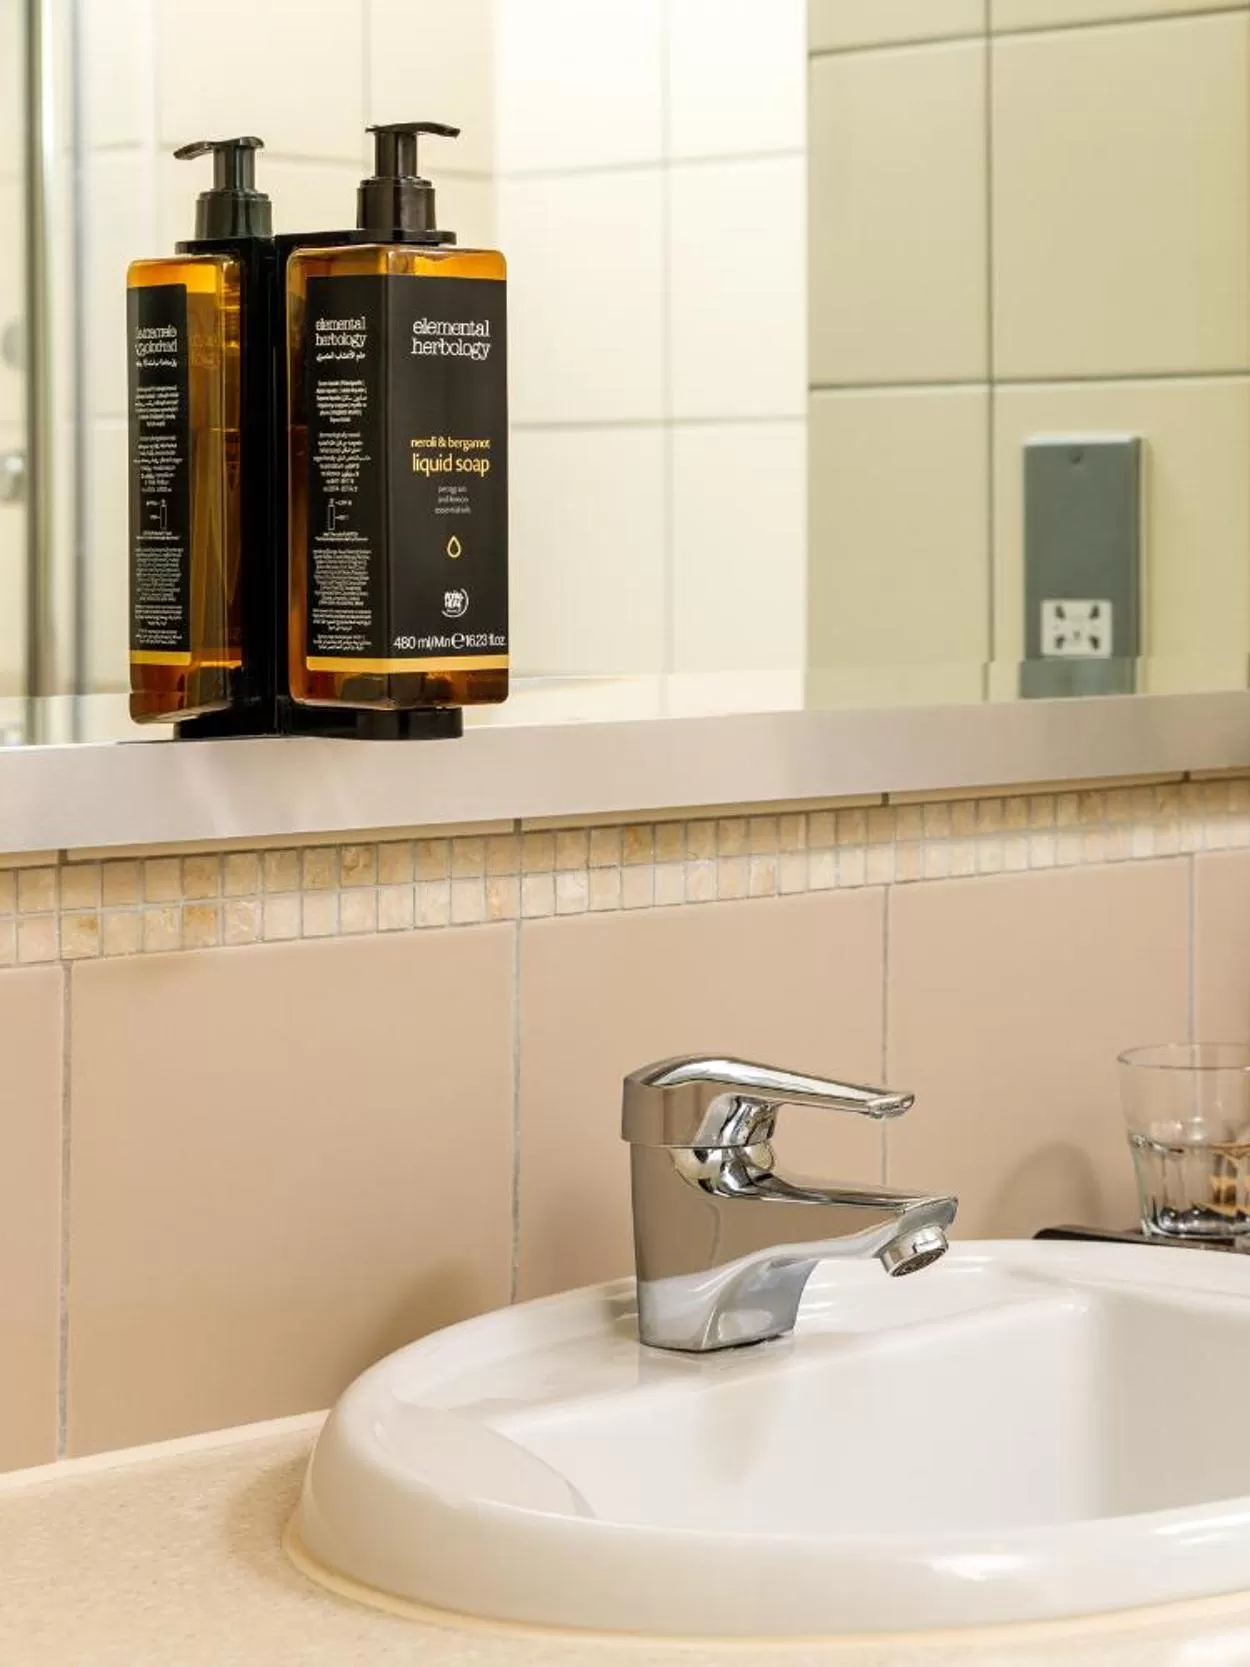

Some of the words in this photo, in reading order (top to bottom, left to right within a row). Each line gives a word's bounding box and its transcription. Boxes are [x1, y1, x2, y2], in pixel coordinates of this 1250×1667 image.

[315, 316, 366, 331] elemental
[412, 317, 490, 337] elemental
[315, 333, 367, 348] herbology
[411, 338, 491, 360] herbology
[411, 437, 437, 448] neroli
[438, 437, 446, 448] &
[448, 437, 491, 452] bergamot
[412, 453, 453, 478] liquid
[455, 458, 490, 478] soap
[393, 636, 416, 649] 480
